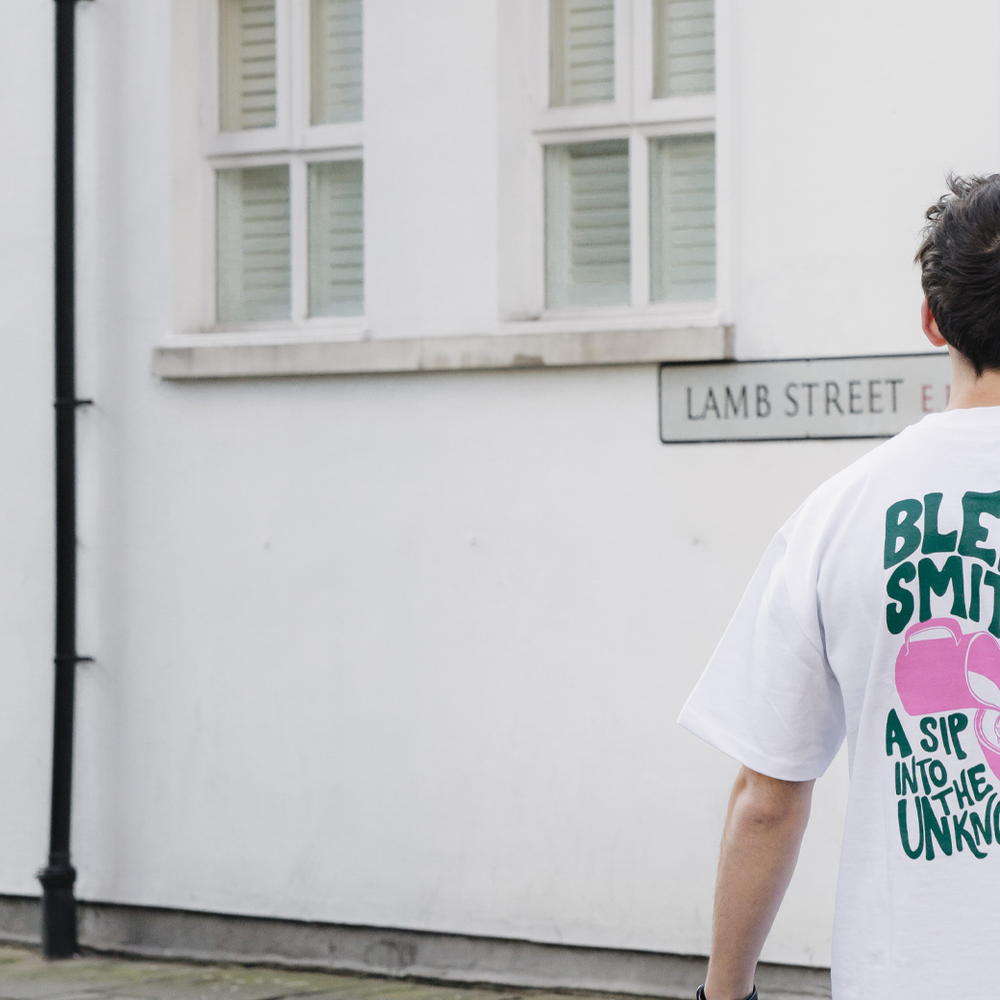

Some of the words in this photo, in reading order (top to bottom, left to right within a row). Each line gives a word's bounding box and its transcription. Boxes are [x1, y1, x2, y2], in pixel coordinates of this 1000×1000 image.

[686, 385, 771, 420] LAMB
[784, 379, 904, 416] STREET
[886, 708, 912, 758] A
[919, 712, 968, 760] SIP
[895, 755, 947, 796] INTO
[931, 763, 994, 816] THE
